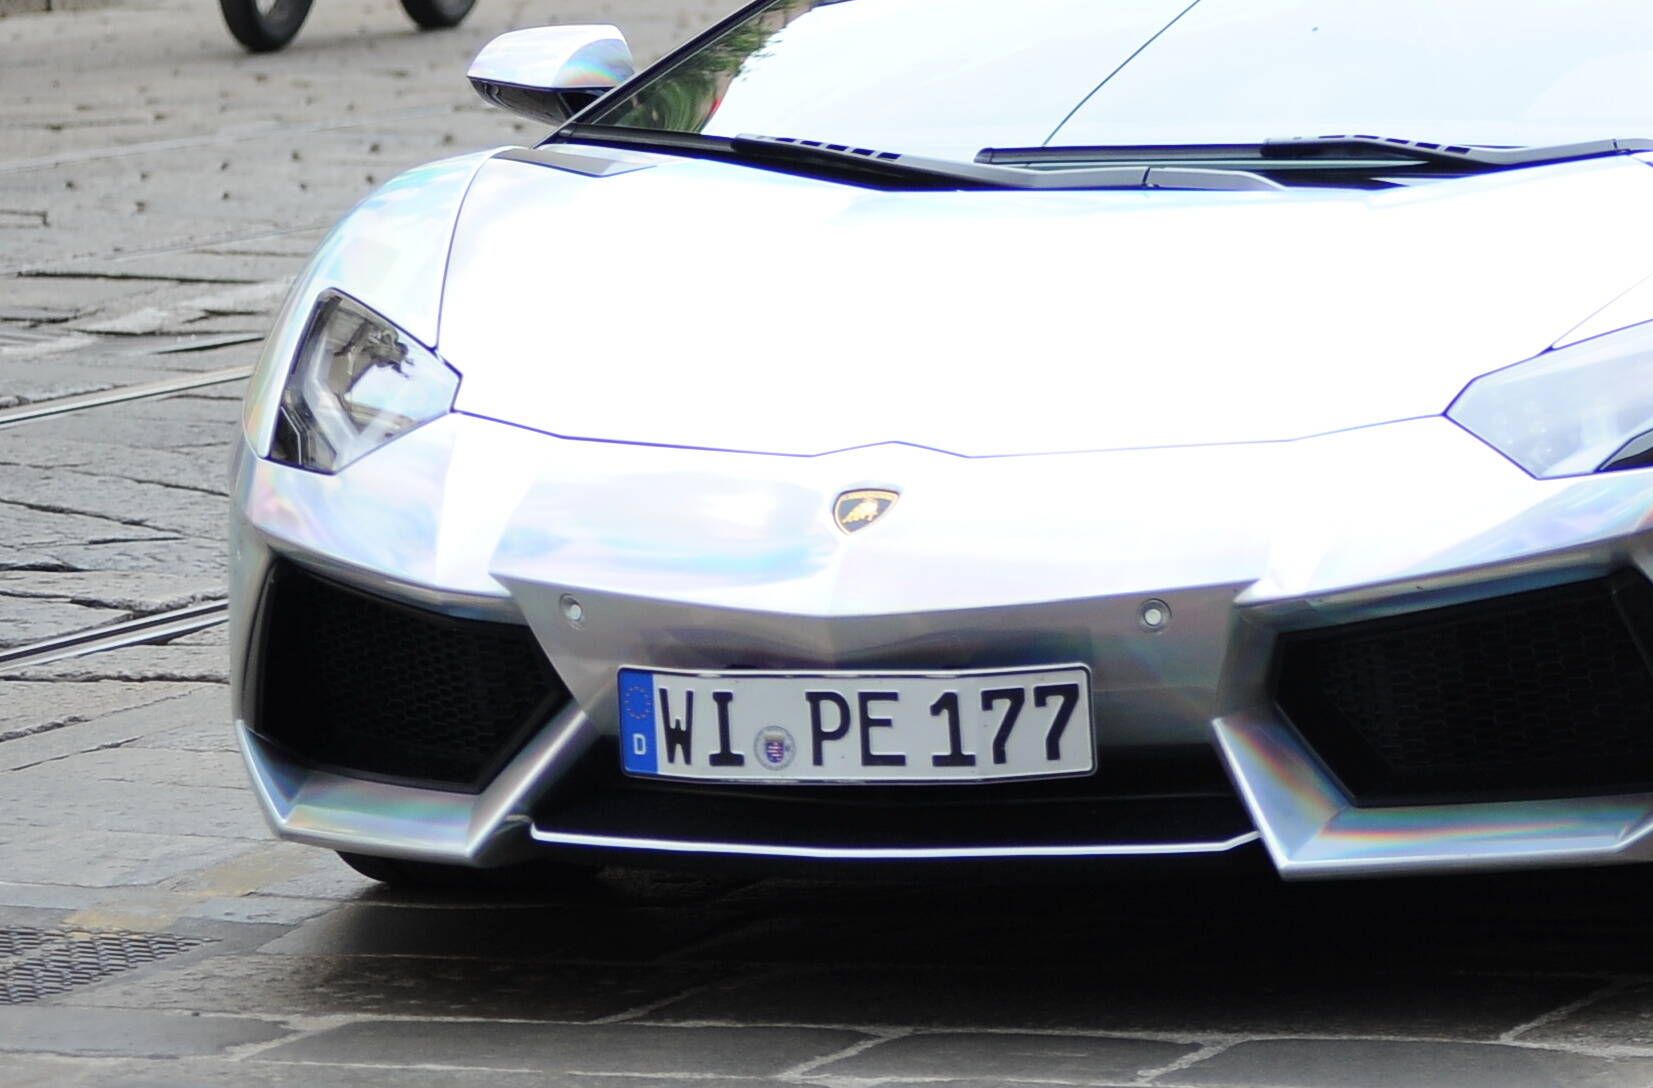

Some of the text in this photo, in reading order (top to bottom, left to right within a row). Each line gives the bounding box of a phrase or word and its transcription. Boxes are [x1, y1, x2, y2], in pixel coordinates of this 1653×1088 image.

[633, 733, 647, 755] D
[659, 683, 1080, 768] WI PE 177
